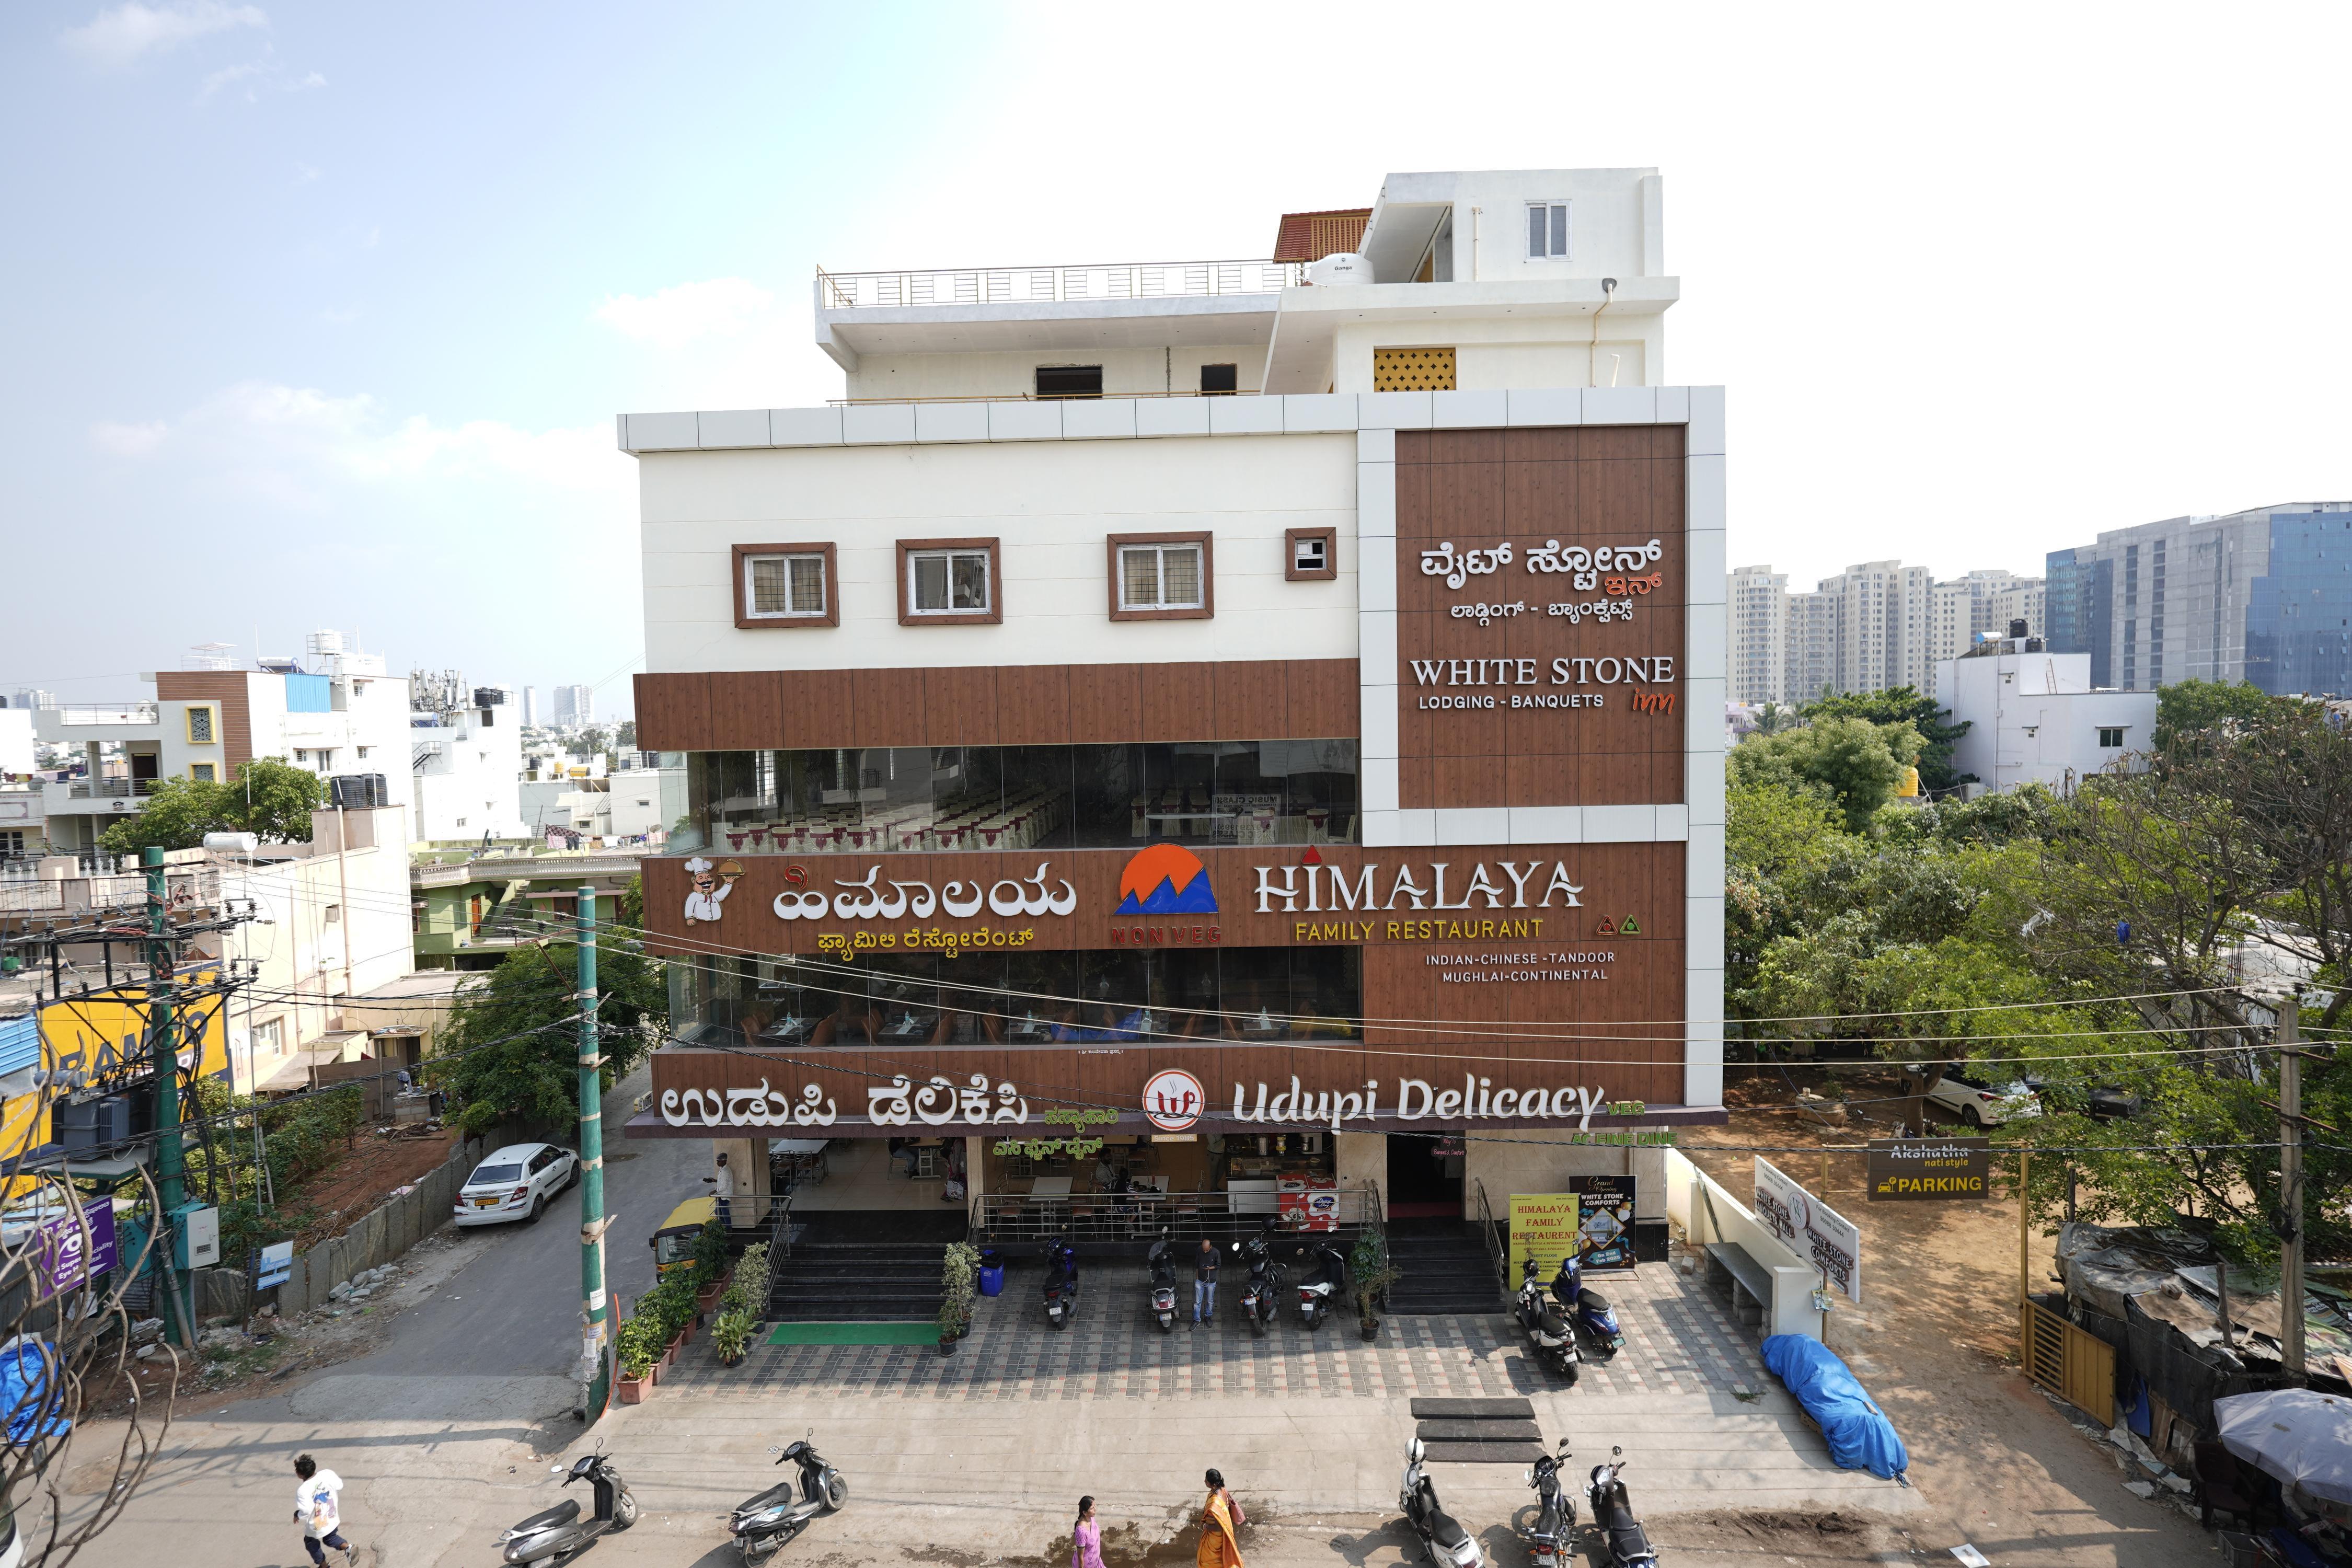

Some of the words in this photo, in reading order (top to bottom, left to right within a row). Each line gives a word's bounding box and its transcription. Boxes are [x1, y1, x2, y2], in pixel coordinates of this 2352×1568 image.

[1421, 541, 1513, 590] ವೈಟ್
[1526, 539, 1662, 591] ಸ್ಟೋನ್
[1605, 571, 1662, 596] ಇನ್
[1410, 659, 1538, 686] WHITE
[1551, 656, 1675, 685] STONE
[1419, 696, 1495, 709] LODGING
[1512, 695, 1604, 708] BANQUETS
[1632, 688, 1676, 715] inn
[773, 862, 1077, 921] ಹಿಮಾಲಯ
[1253, 860, 1584, 913] HIMALAYA
[1112, 926, 1163, 944] NON
[1172, 925, 1221, 944] VEG
[1296, 921, 1375, 942] FAMILY
[1388, 918, 1544, 940] RESTAURANT
[1443, 969, 1608, 983] MUGHLAI-CONTINENTAL
[59, 1010, 209, 1092] RAMO
[661, 1076, 836, 1127] ಉಡುಪಿ
[868, 1073, 1028, 1126] ಡೆಲಿಕೆಸಿ
[1234, 1074, 1378, 1135] Udupi
[1397, 1071, 1605, 1133] Delicacy
[1606, 1100, 1645, 1115] VEG
[1044, 1104, 1119, 1134] ಸಸ್ಯಾಹಾರಿ
[1596, 1133, 1634, 1146] FINE
[1638, 1132, 1678, 1146] DINE
[1891, 1144, 1968, 1159] Akshatha
[1924, 1159, 1943, 1167] nati
[1945, 1158, 1968, 1169] style
[1588, 1176, 1615, 1191] Grand
[1898, 1177, 1982, 1193] PARKING
[1518, 1204, 1572, 1213] HIMALAYA
[1756, 1187, 1772, 1206] WHITE
[1772, 1200, 1789, 1219] STONE
[1526, 1217, 1564, 1226] FAMILY
[1754, 1198, 1778, 1226] BANQUETS
[1778, 1218, 1792, 1238] HALL
[1821, 1208, 1836, 1223] Booking
[1836, 1219, 1850, 1232] Contact
[1806, 1227, 1827, 1250] WHITE
[1828, 1244, 1851, 1268] STONE
[59, 1269, 72, 1280] Eye
[61, 1256, 82, 1271] Super
[1811, 1246, 1846, 1281] COMFORTS
